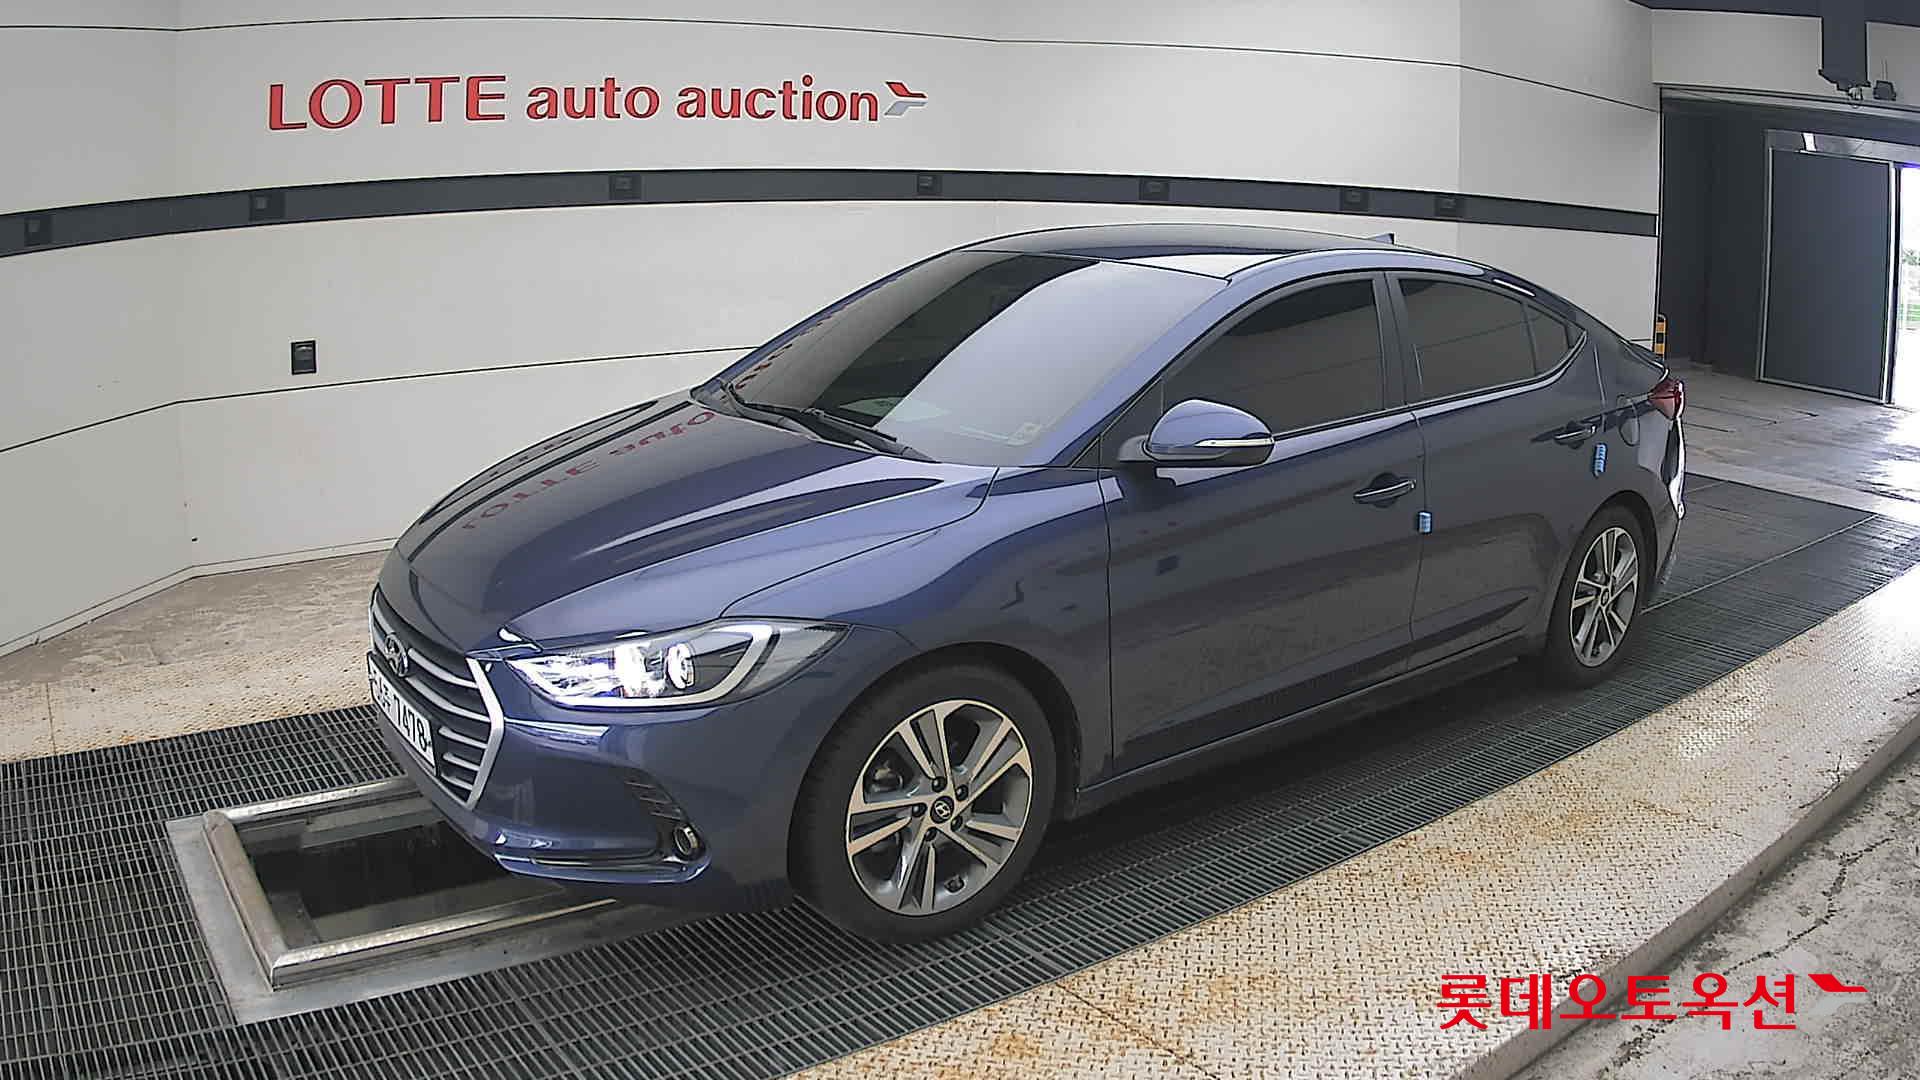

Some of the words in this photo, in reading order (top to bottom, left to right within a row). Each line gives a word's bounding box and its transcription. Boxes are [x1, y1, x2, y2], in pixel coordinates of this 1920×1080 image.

[268, 75, 507, 131] LOTTE
[526, 77, 660, 121] auto
[676, 74, 879, 122] auction
